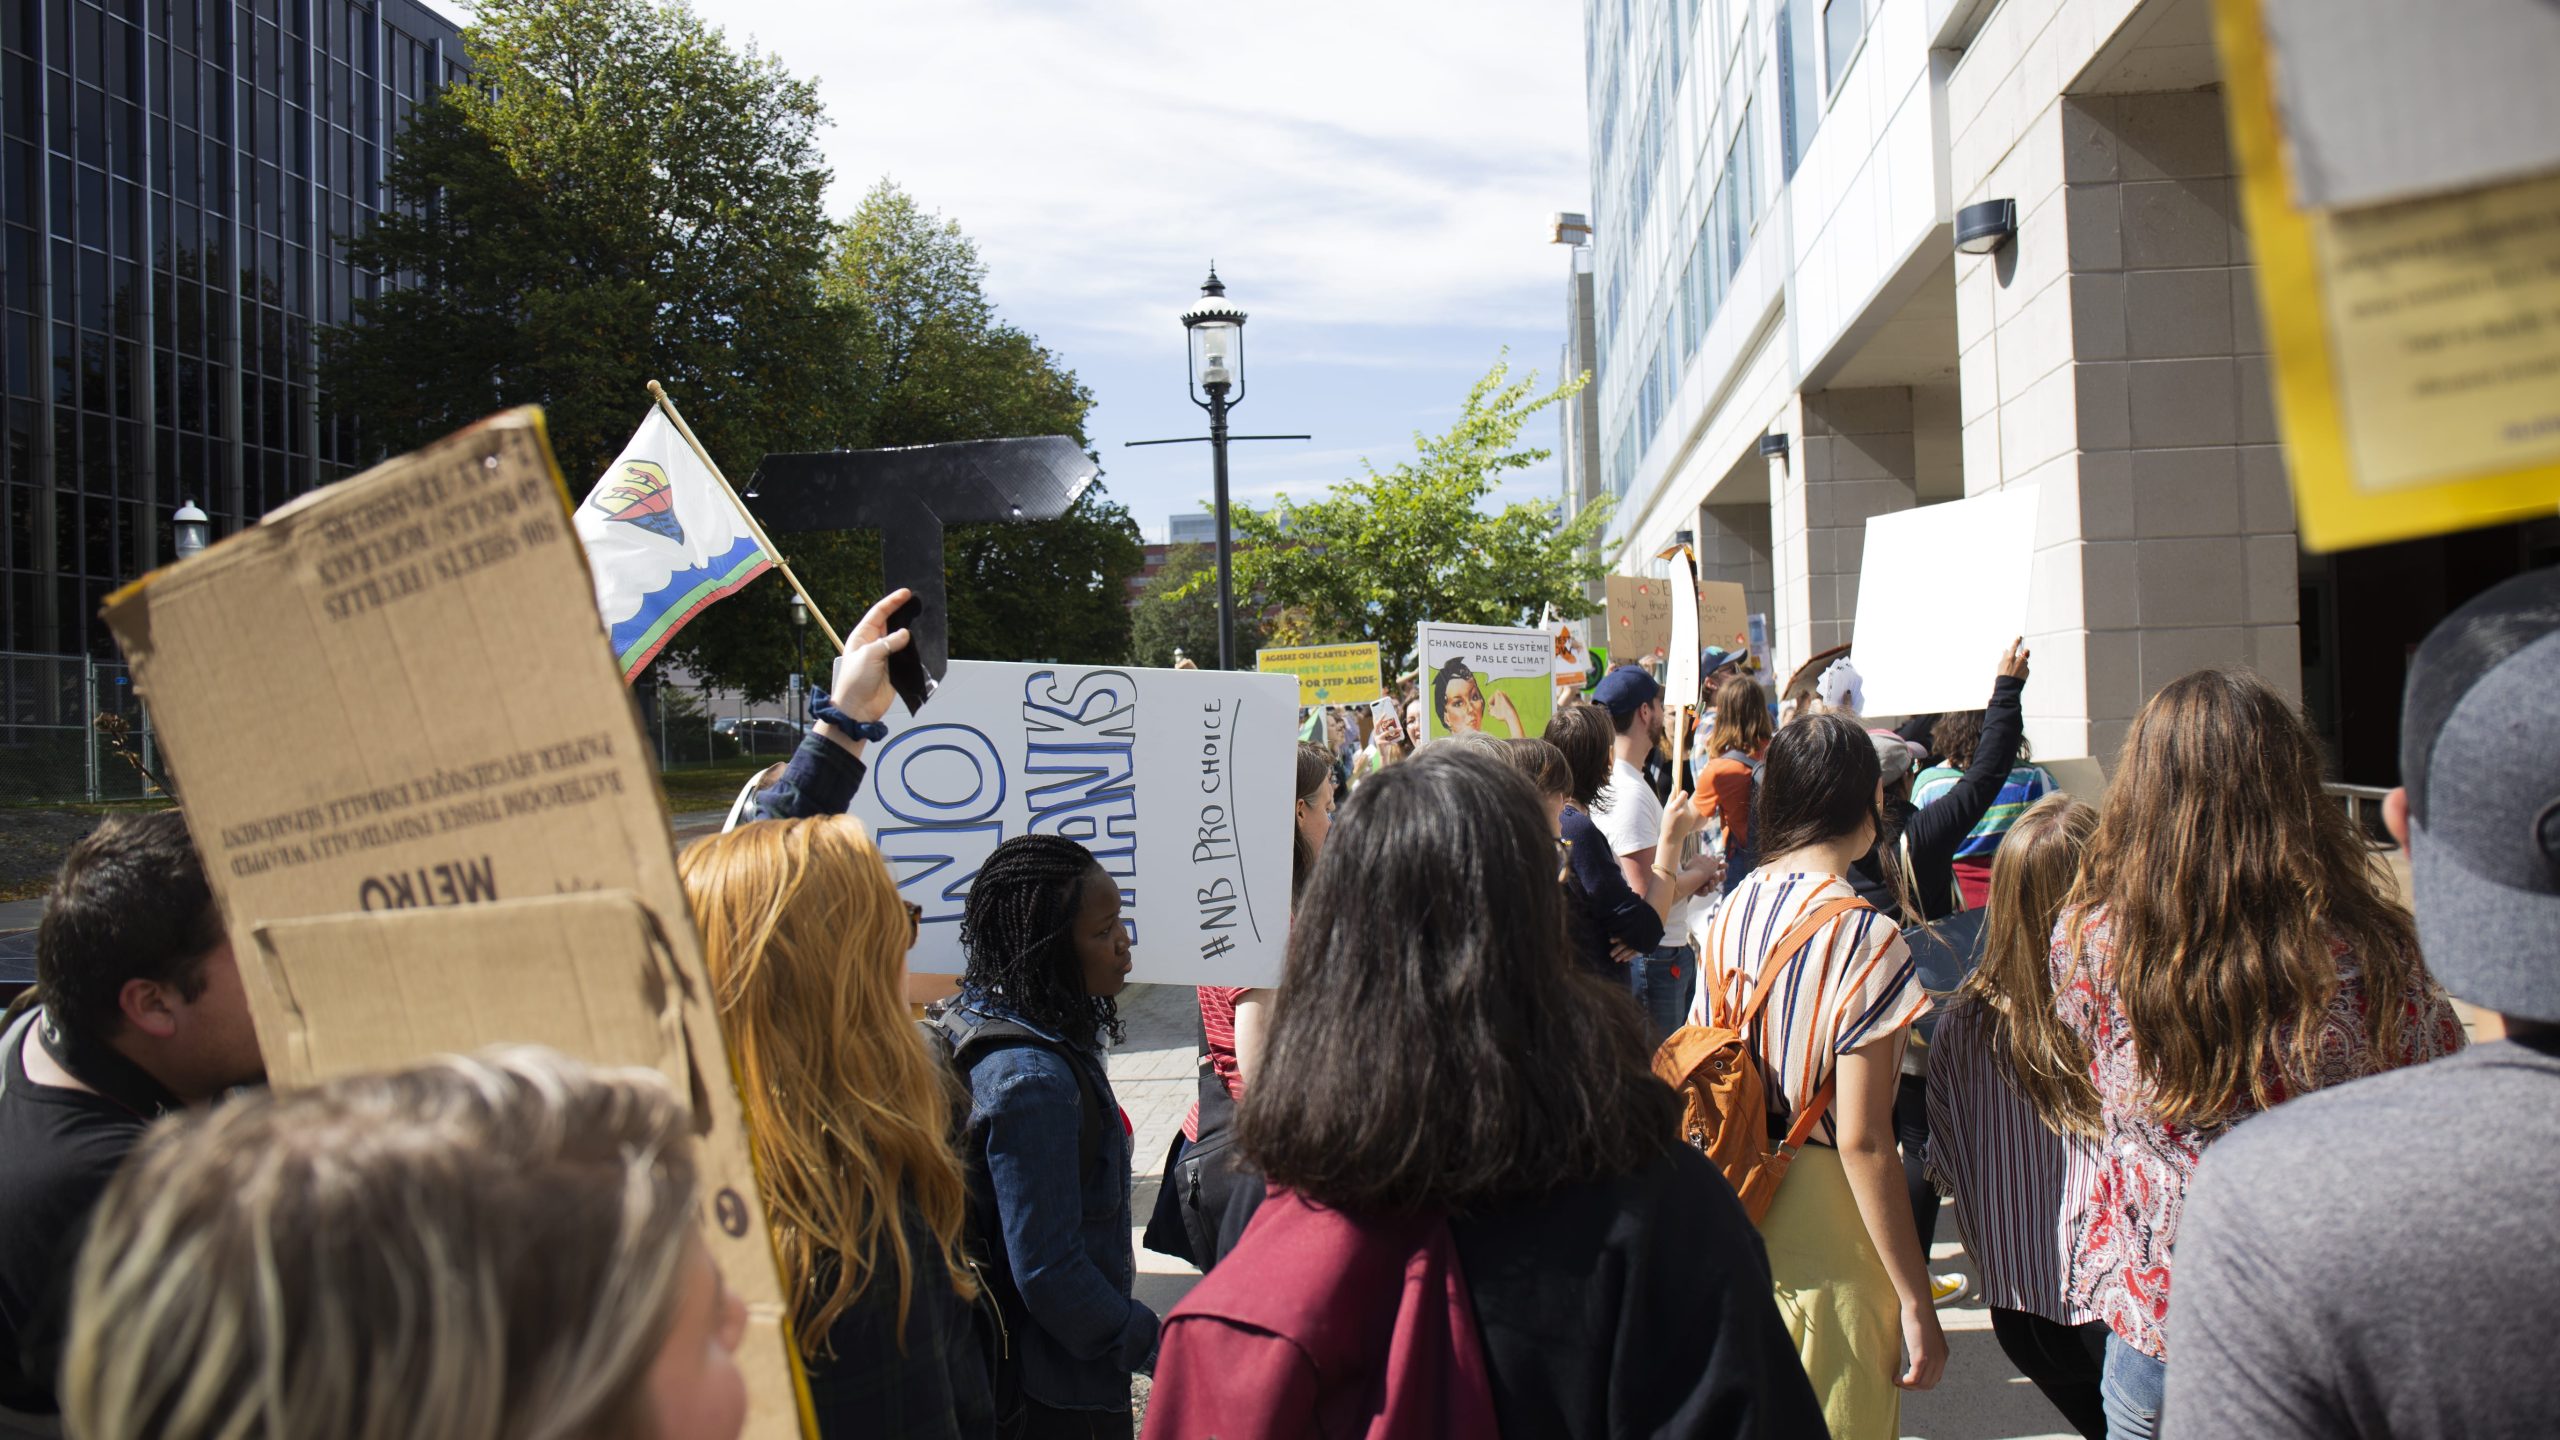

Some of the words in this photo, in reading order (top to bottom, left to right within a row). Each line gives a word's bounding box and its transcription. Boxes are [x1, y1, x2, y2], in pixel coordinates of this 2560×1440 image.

[1428, 639, 1488, 650] CHANGEONS
[1493, 642, 1504, 651] LE
[1507, 640, 1549, 653] SYSTÈME
[1475, 654, 1494, 664] PAS
[1496, 655, 1508, 664] LE
[1511, 656, 1545, 665] CLIMAT
[1298, 666, 1320, 674] NEW
[1323, 663, 1347, 673] DEAL
[1305, 679, 1320, 688] OR
[1323, 677, 1344, 687] STEP
[1201, 698, 1221, 794] CHOICE
[874, 723, 1006, 924] NO
[1192, 804, 1237, 865] PRO
[1197, 877, 1238, 960] #NB
